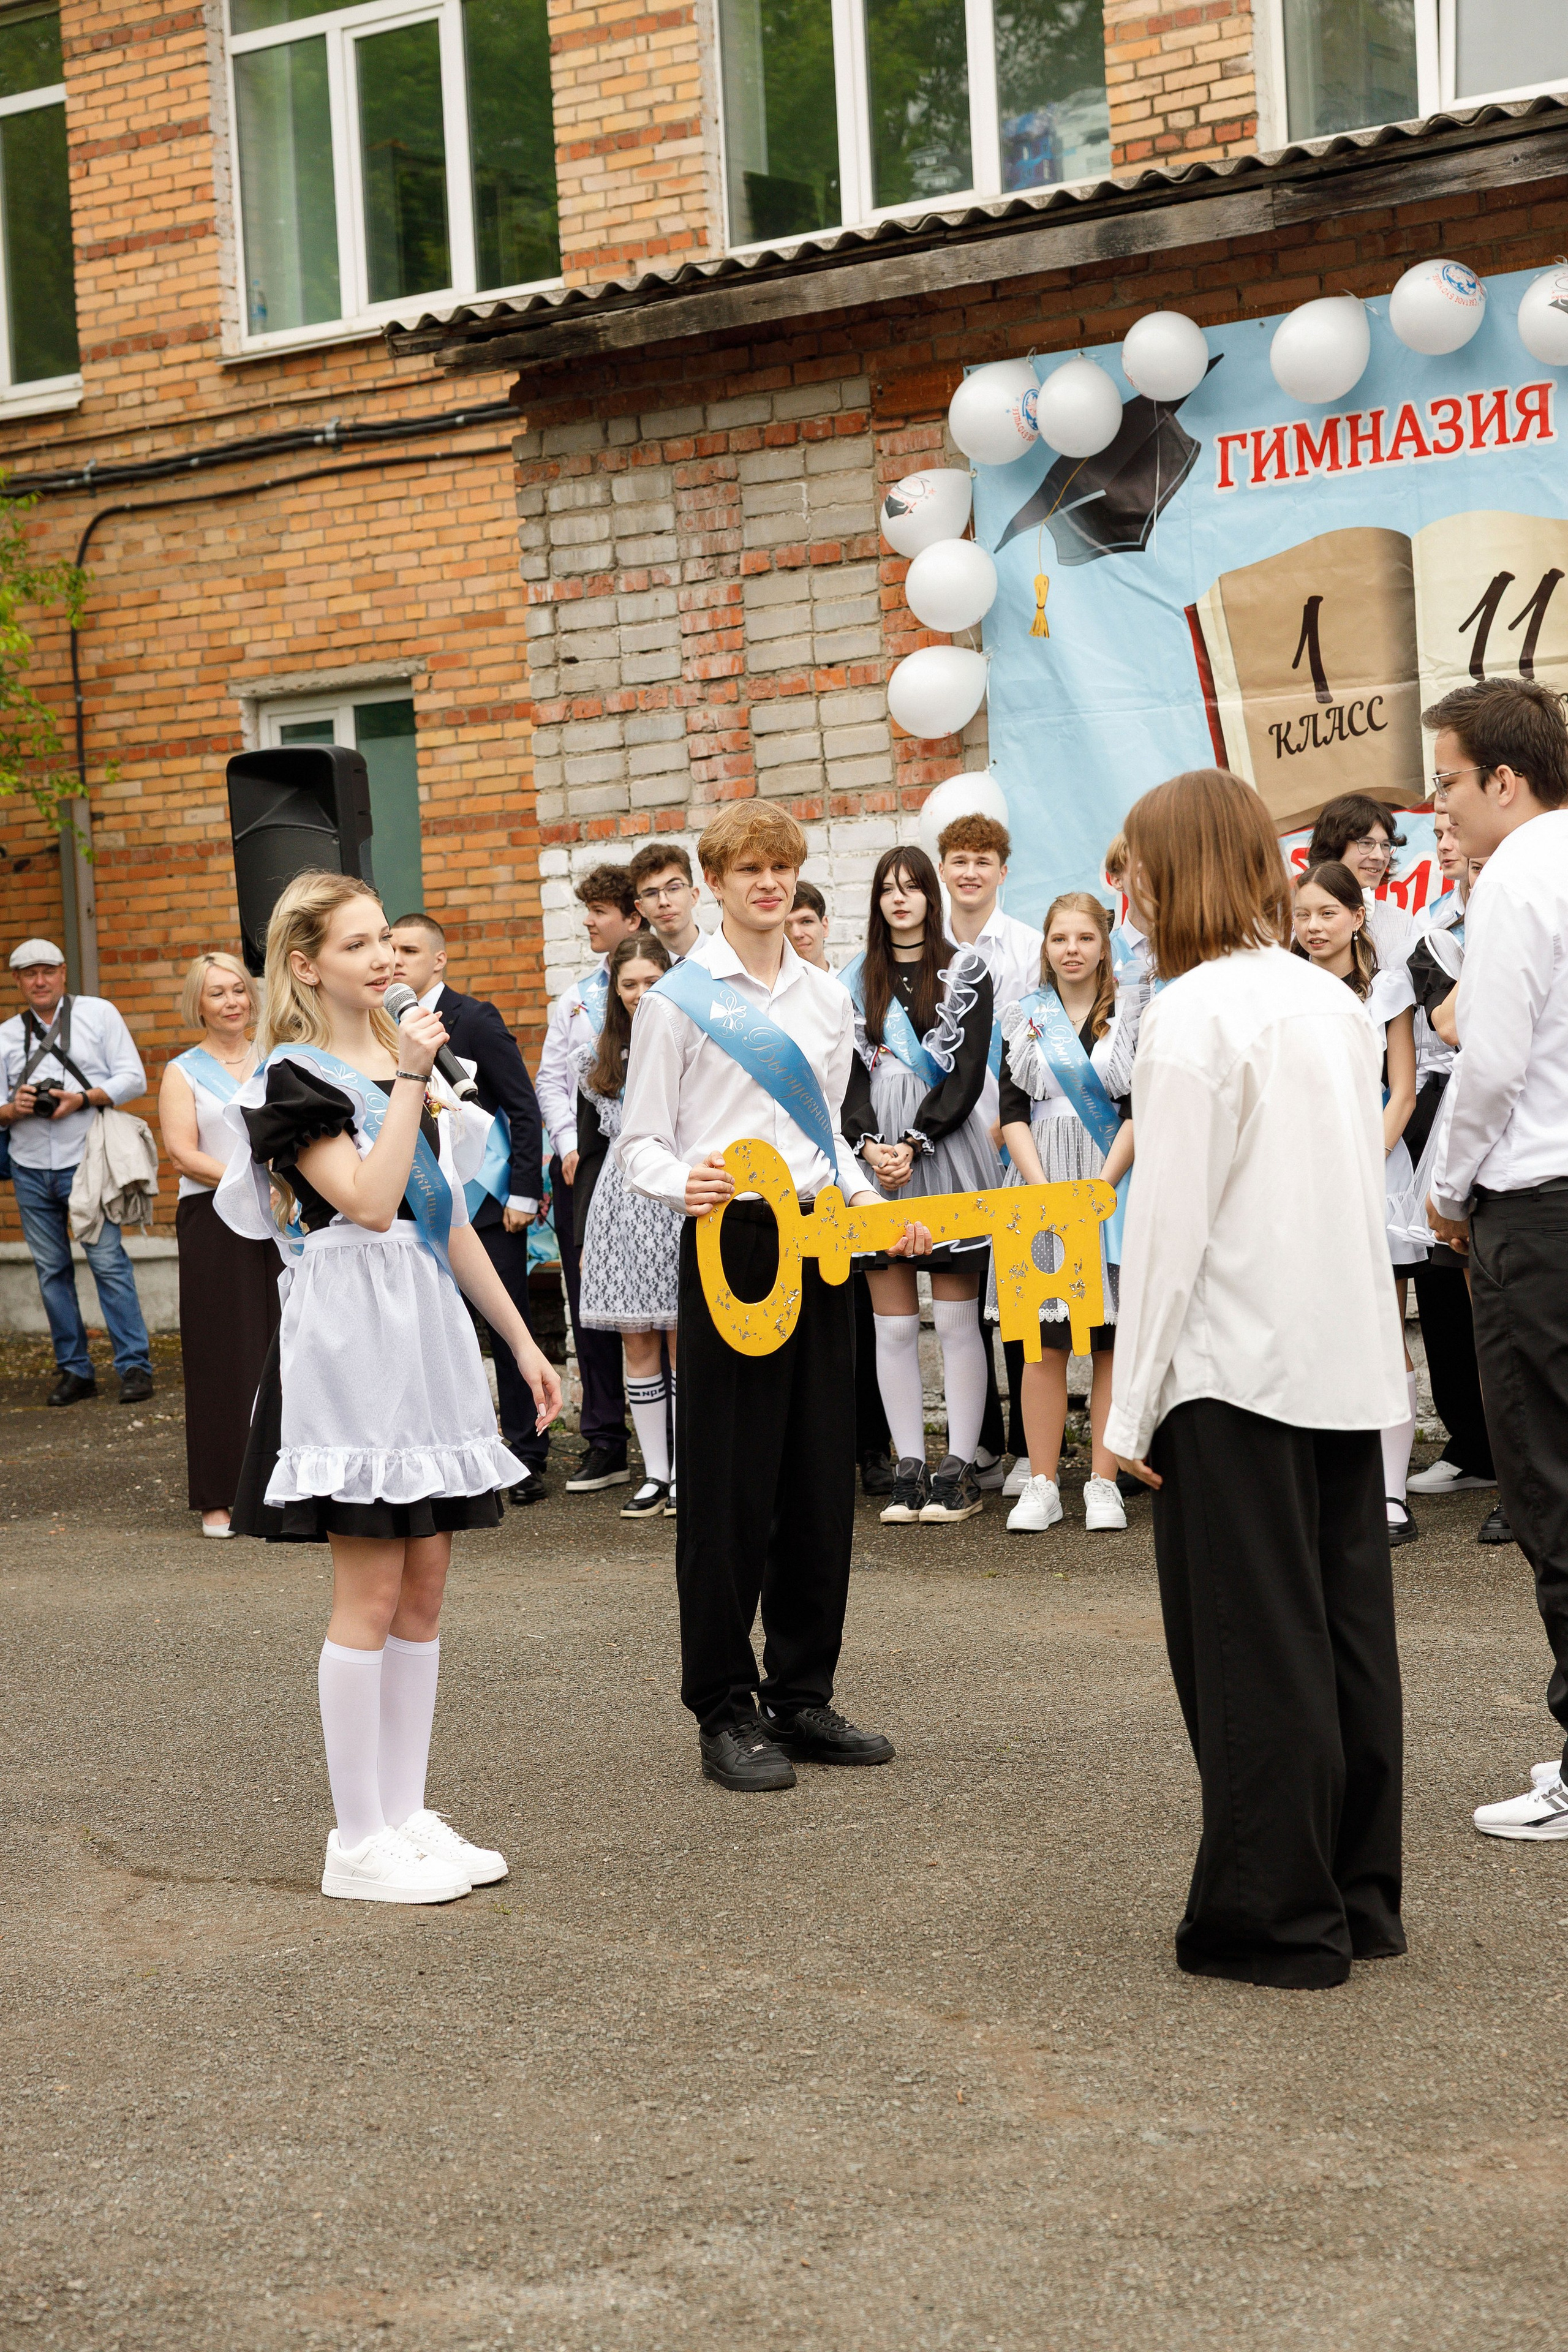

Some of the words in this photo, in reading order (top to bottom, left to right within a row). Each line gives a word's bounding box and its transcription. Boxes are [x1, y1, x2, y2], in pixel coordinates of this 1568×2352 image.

[1218, 382, 1553, 488] ГИМНАЗИЯ
[1292, 595, 1333, 704] 1
[1458, 568, 1566, 681] 11
[1268, 695, 1389, 760] КЛАСС
[742, 1027, 831, 1135] Выпускник
